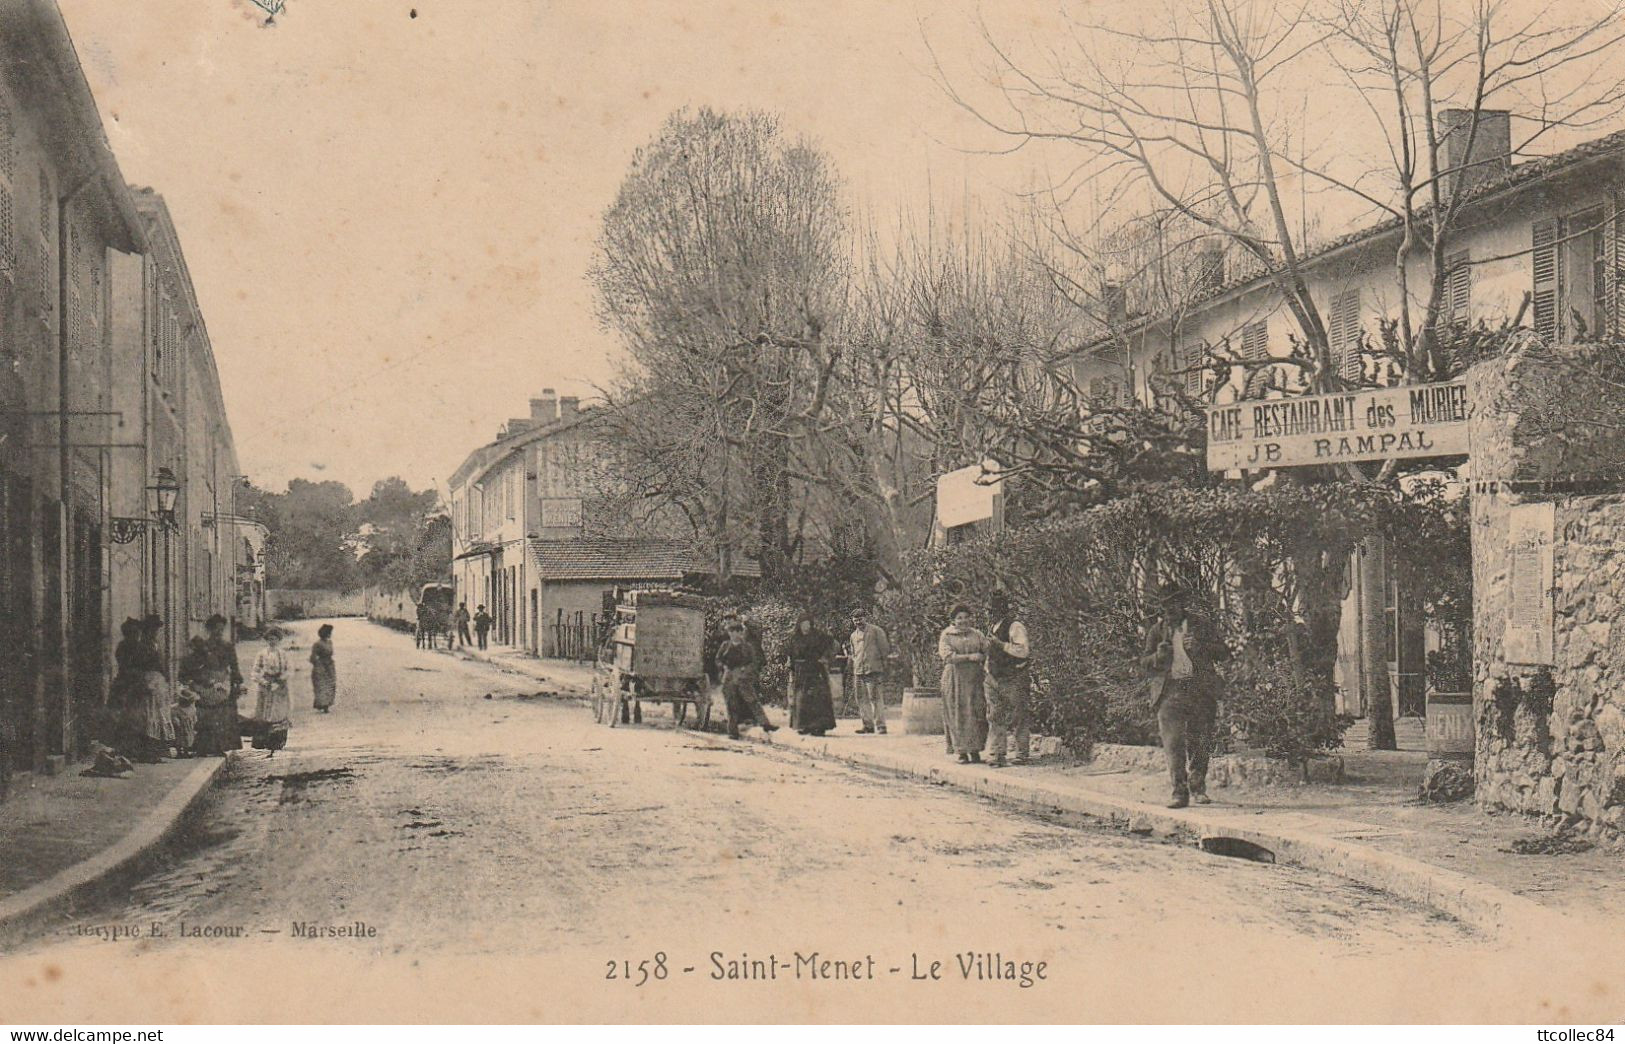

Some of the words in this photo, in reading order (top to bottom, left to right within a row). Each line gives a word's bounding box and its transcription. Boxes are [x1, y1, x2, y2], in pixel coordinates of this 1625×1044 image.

[1253, 397, 1356, 438] RESTAURANT
[1367, 397, 1396, 428] des
[1247, 443, 1282, 462] JB
[1314, 431, 1434, 457] RAMPAL
[150, 922, 168, 937] E.
[181, 922, 249, 938] Lacour.
[291, 921, 377, 938] Marseille
[605, 951, 668, 987] 2158
[710, 951, 876, 980] Saint-Menet
[912, 952, 942, 980] Le
[956, 951, 1048, 988] Village
